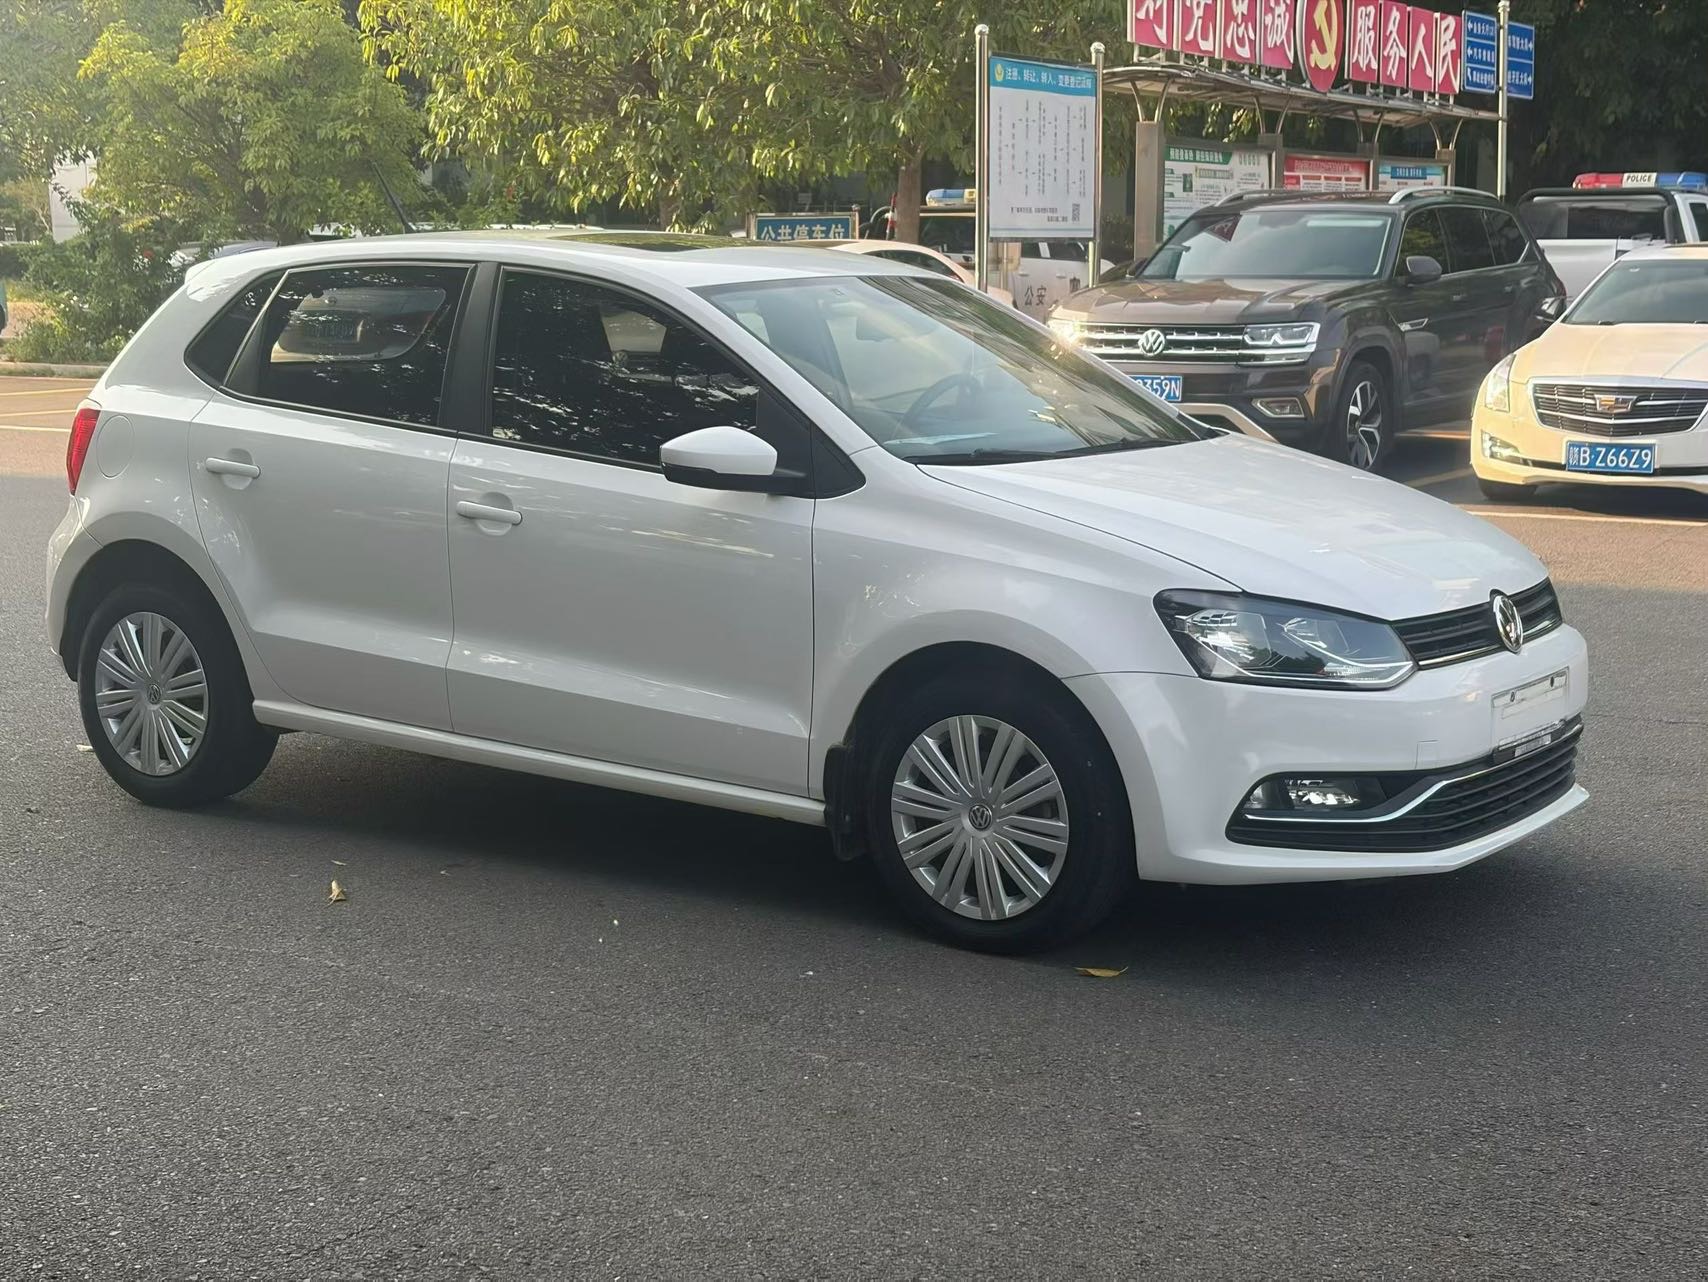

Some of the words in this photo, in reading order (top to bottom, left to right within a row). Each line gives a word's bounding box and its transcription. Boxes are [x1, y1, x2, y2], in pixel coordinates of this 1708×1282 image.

[1353, 5, 1460, 94] 服务人民
[1626, 174, 1653, 183] POLICE
[761, 224, 845, 240] 公共停车位
[1024, 284, 1047, 306] 公安
[1136, 379, 1180, 400] 359N
